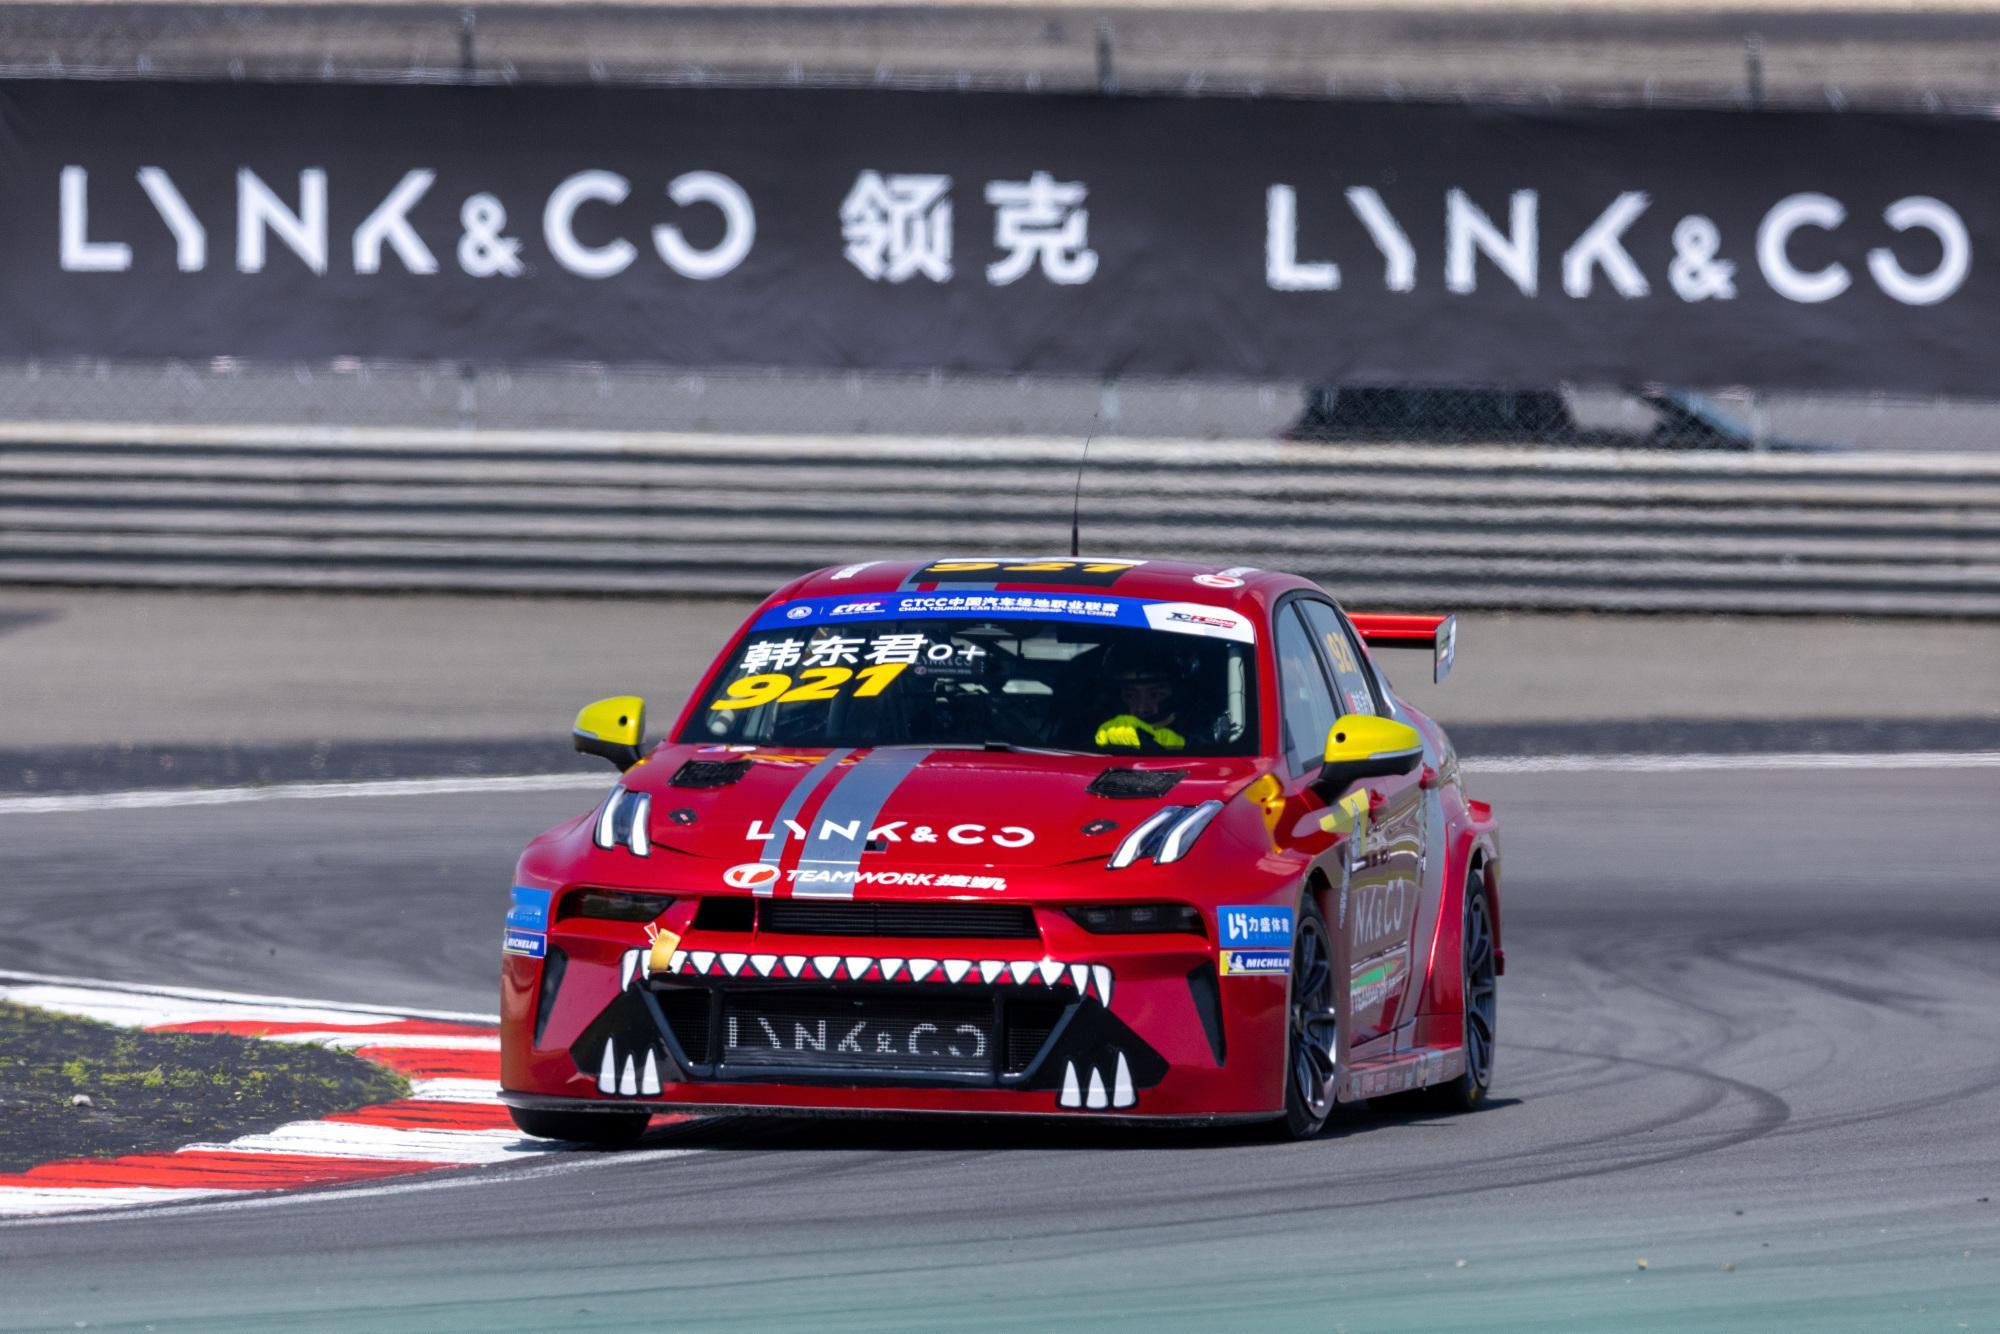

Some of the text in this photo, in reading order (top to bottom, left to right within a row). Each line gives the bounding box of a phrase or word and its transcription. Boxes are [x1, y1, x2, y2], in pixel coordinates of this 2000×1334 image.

[840, 170, 1099, 286] 领克
[926, 562, 1136, 573] 921
[740, 634, 928, 673] 韩东君
[710, 661, 909, 710] 921
[787, 869, 936, 887] TEAMWORK
